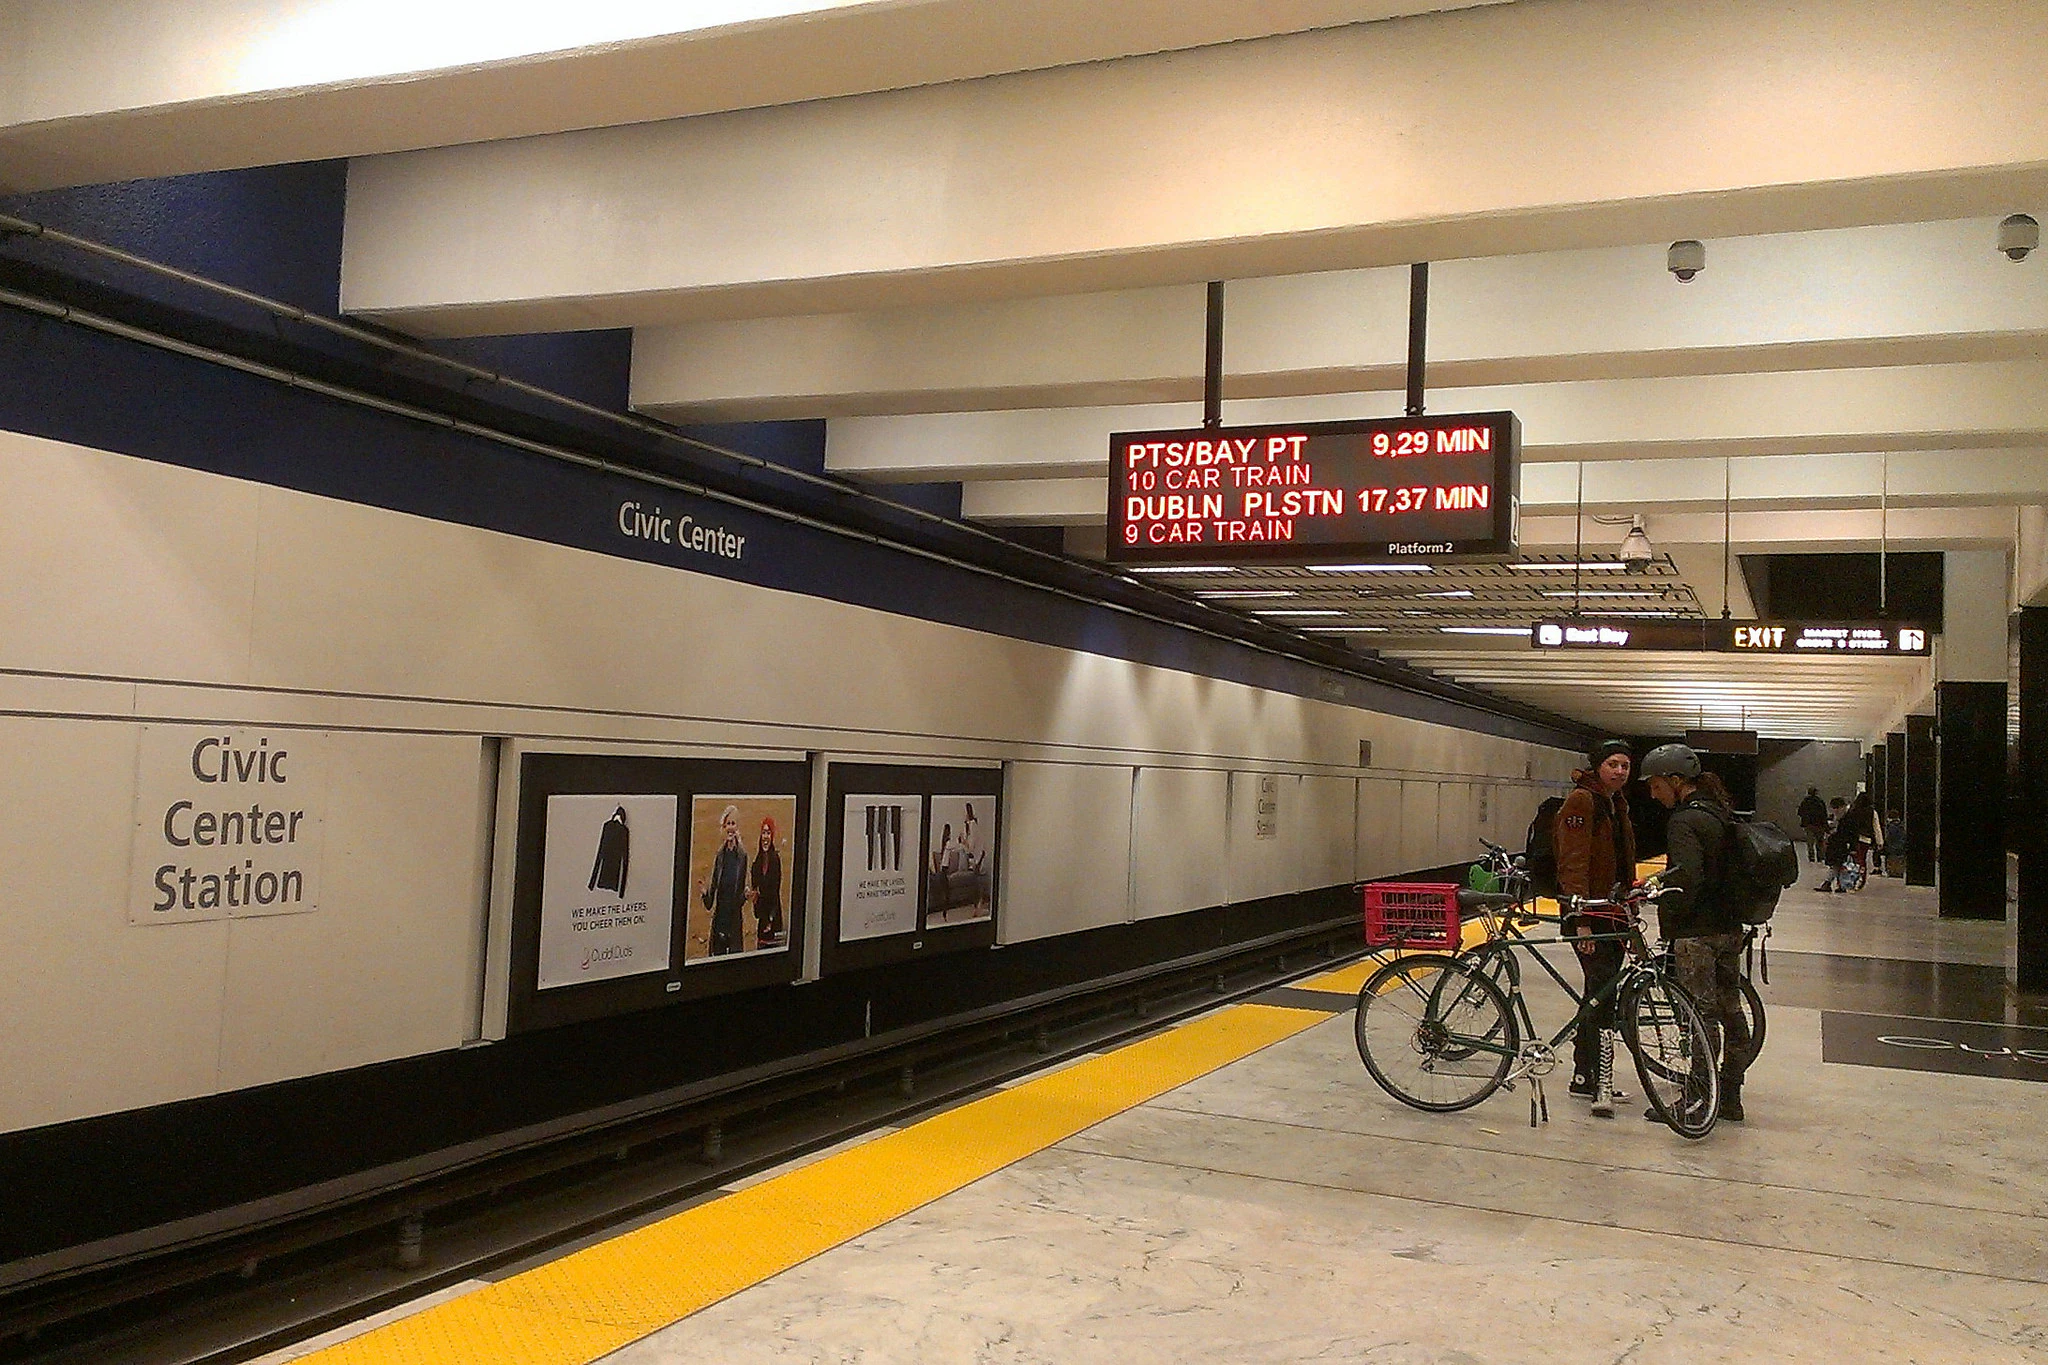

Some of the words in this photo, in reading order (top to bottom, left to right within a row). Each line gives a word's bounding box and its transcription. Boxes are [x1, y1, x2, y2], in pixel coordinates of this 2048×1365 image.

[1129, 439, 1257, 468] PTS/BAY
[1267, 436, 1308, 463] PT
[1373, 432, 1429, 458] 9,29
[1437, 427, 1490, 453] MIN
[1128, 471, 1156, 491] 10
[1166, 468, 1220, 489] CAR
[1230, 464, 1310, 487] TRAIN
[1127, 494, 1223, 521] DUBLN
[1244, 489, 1343, 517] PLSTN
[1358, 487, 1428, 514] 17,37
[1435, 485, 1488, 510] MIN
[619, 501, 671, 544] Civic
[678, 515, 745, 559] Center
[1125, 524, 1139, 544] 9
[1149, 522, 1203, 543] CAR
[1213, 519, 1292, 541] TRAIN
[1388, 542, 1444, 555] Platform
[1445, 542, 1453, 553] 2
[1734, 627, 1786, 648] EXIT
[192, 736, 287, 783] Civic
[164, 800, 304, 847] Center
[153, 859, 303, 912] Station
[571, 908, 584, 918] WE
[586, 906, 607, 917] MAKE
[608, 904, 621, 915] THE
[572, 921, 588, 932] YOU
[590, 919, 613, 930] CHEER
[615, 916, 632, 927] THEM
